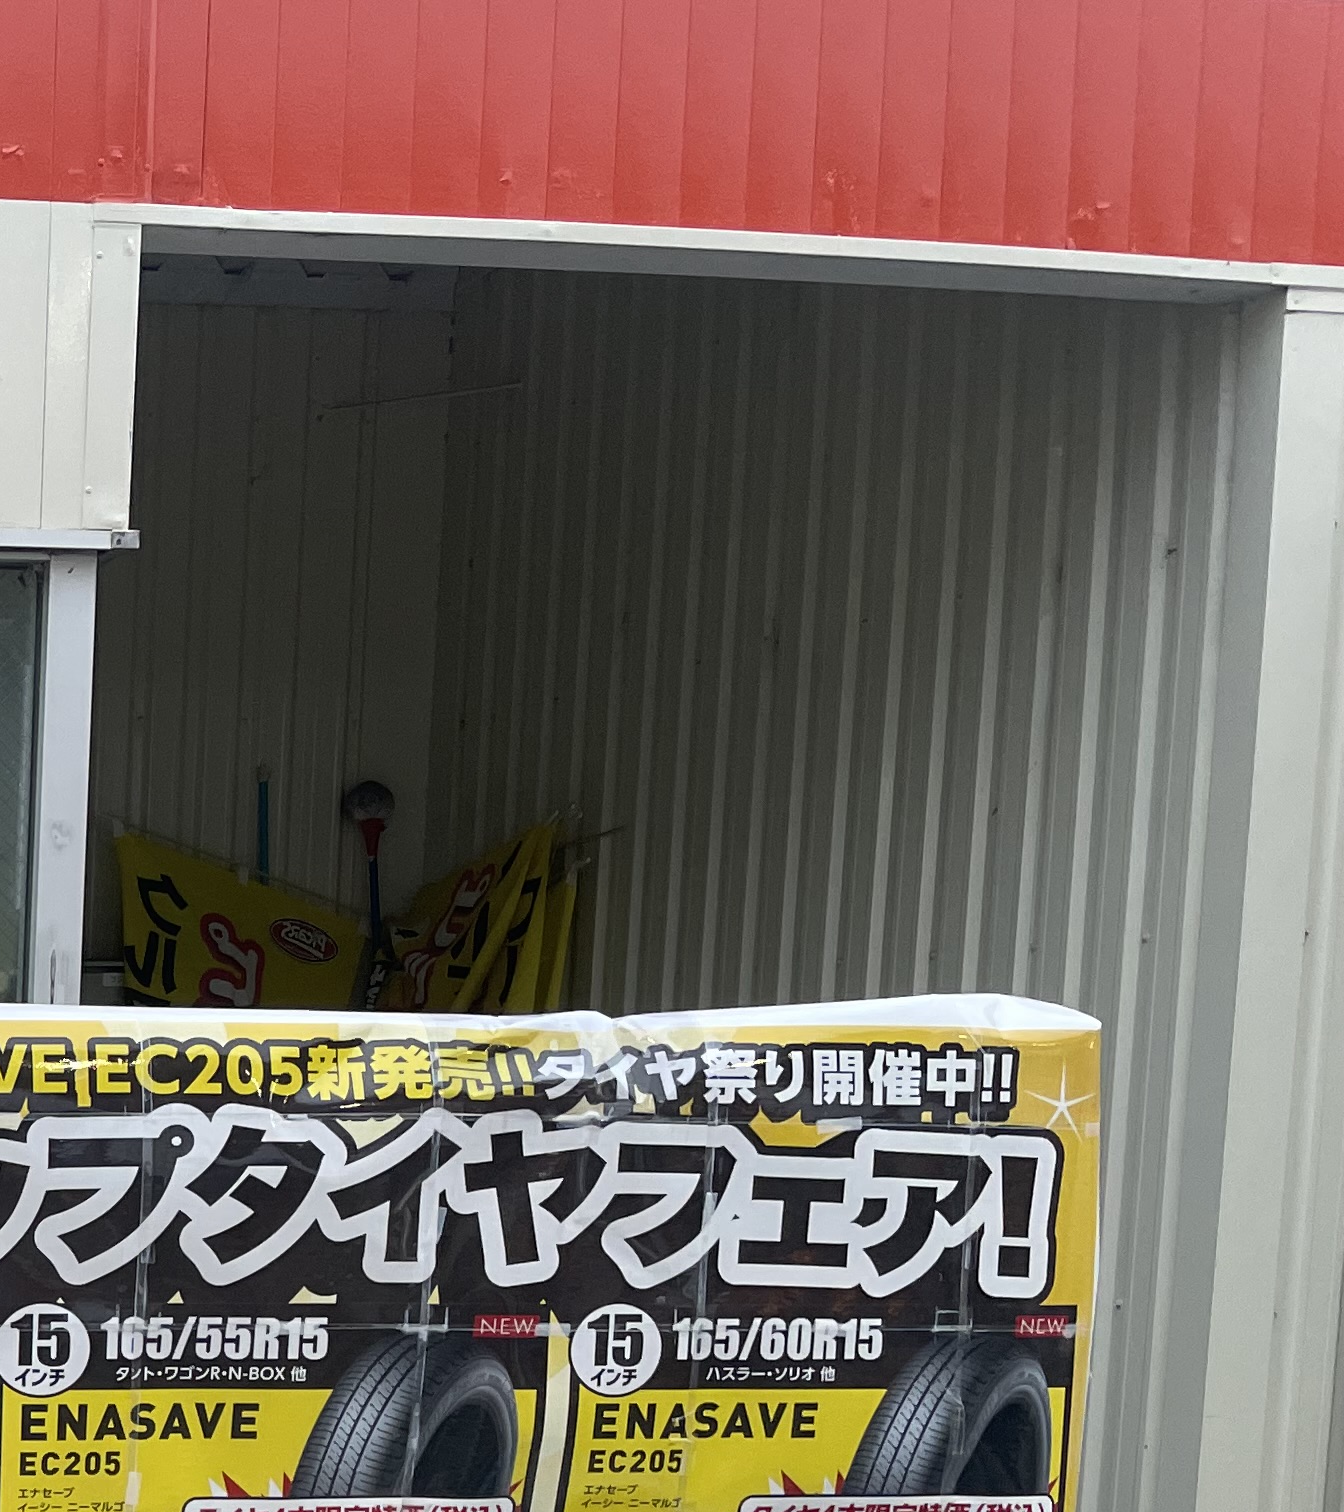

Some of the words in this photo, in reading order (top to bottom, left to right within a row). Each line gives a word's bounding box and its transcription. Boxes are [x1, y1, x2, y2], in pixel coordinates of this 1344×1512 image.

[480, 1318, 535, 1336] NEW
[1019, 1317, 1065, 1334] NEW
[10, 1314, 71, 1368] 15
[102, 1316, 329, 1362] 165/55R15
[587, 1314, 644, 1368] 15
[673, 1317, 883, 1362] 165/60R15
[14, 1367, 66, 1387] インチ
[291, 1365, 307, 1382] 他
[590, 1367, 637, 1387] インチ
[820, 1366, 835, 1382] 他
[20, 1402, 260, 1442] ENASAVE
[592, 1402, 818, 1441] ENASAVE
[19, 1451, 121, 1477] EC205
[588, 1449, 683, 1474] EC205
[18, 1487, 74, 1499] エナセーブ
[583, 1484, 637, 1495] エナセーブ
[68, 1499, 125, 1512] ニーマルゴ
